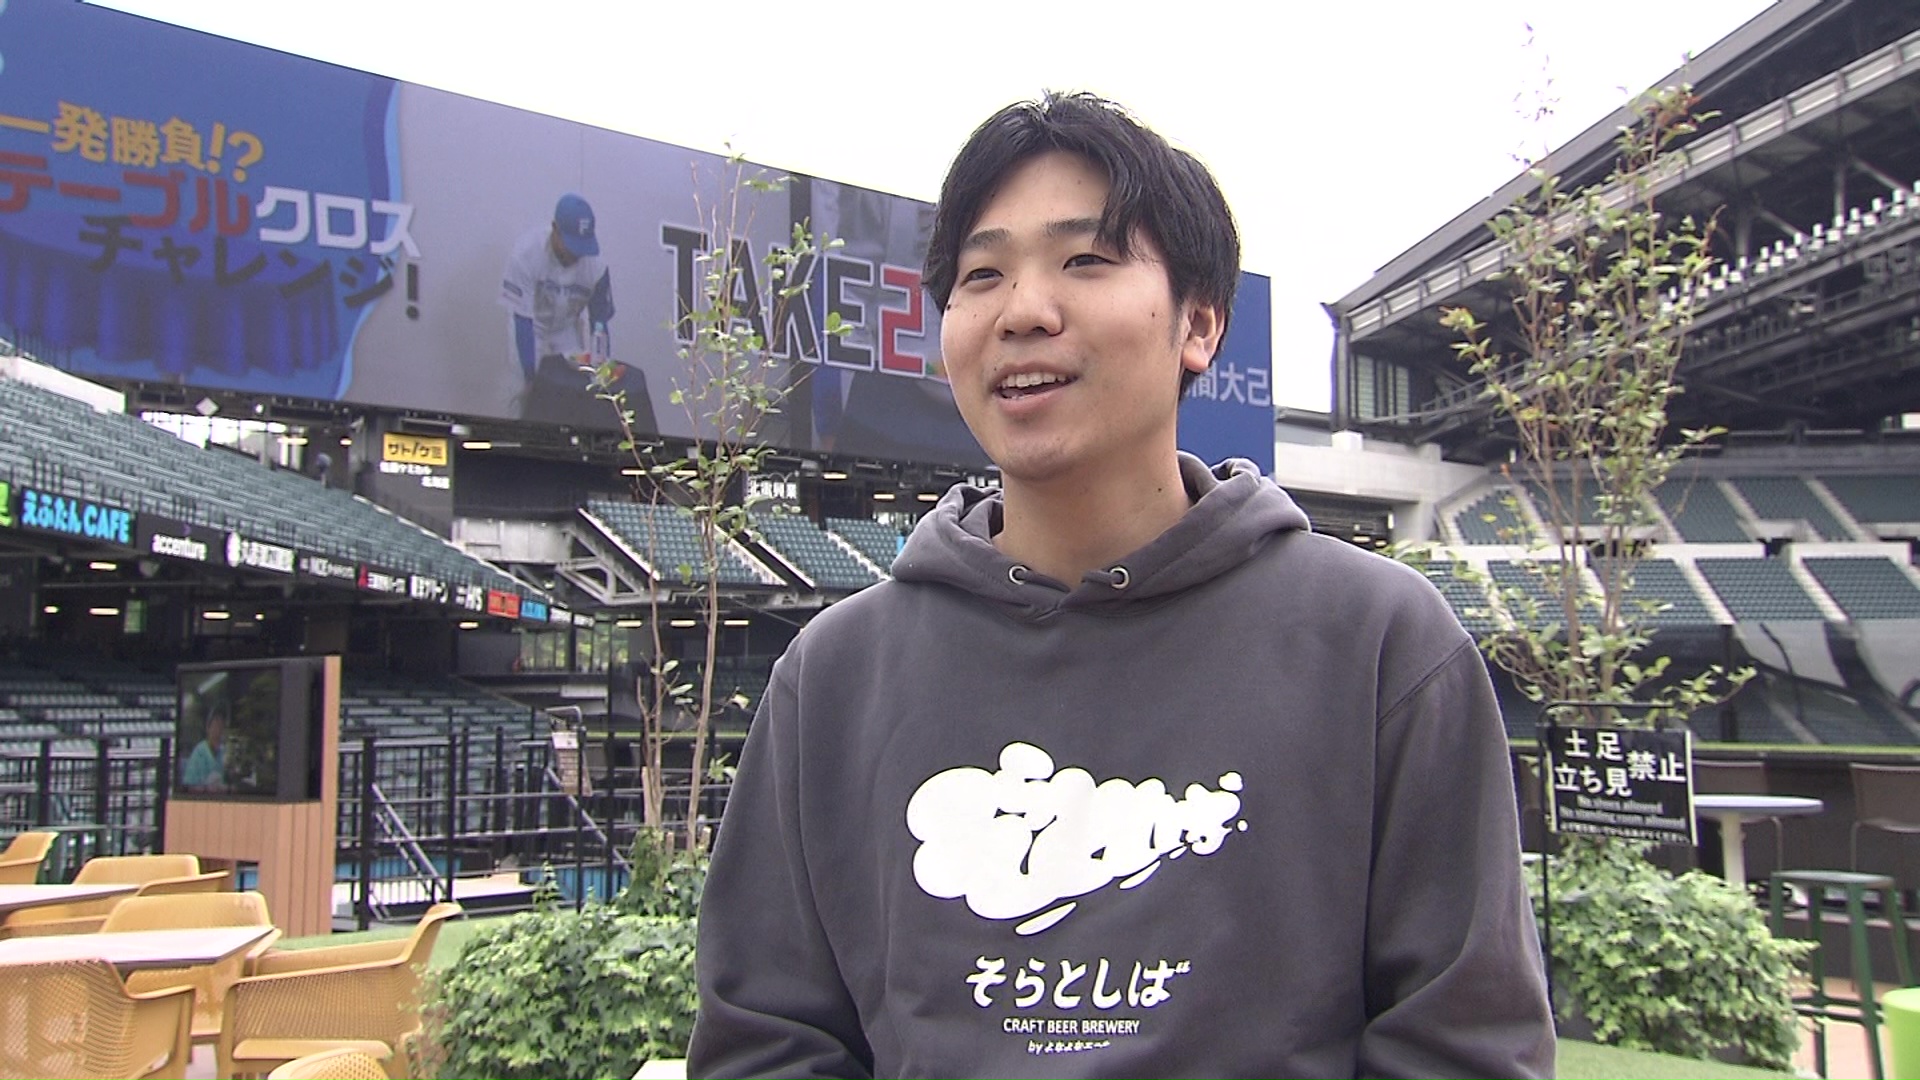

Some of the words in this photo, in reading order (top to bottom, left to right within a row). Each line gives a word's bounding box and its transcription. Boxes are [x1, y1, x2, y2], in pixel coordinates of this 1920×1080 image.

[0, 100, 265, 183] 一発勝負!?
[0, 152, 421, 258] テーブルクロス
[79, 214, 420, 321] チャレンジ!
[660, 224, 926, 378] TAKE2
[1184, 360, 1271, 407] 間大己
[83, 503, 130, 544] CAFE
[1565, 729, 1624, 761] 土足
[1627, 749, 1686, 782] 禁止
[1554, 762, 1632, 797] 立ち見
[966, 955, 1191, 1009] そらとしば
[1003, 1018, 1044, 1033] CRAFT
[1047, 1020, 1078, 1034] BEER
[1082, 1020, 1140, 1034] BREWERY
[1027, 1040, 1043, 1055] by
